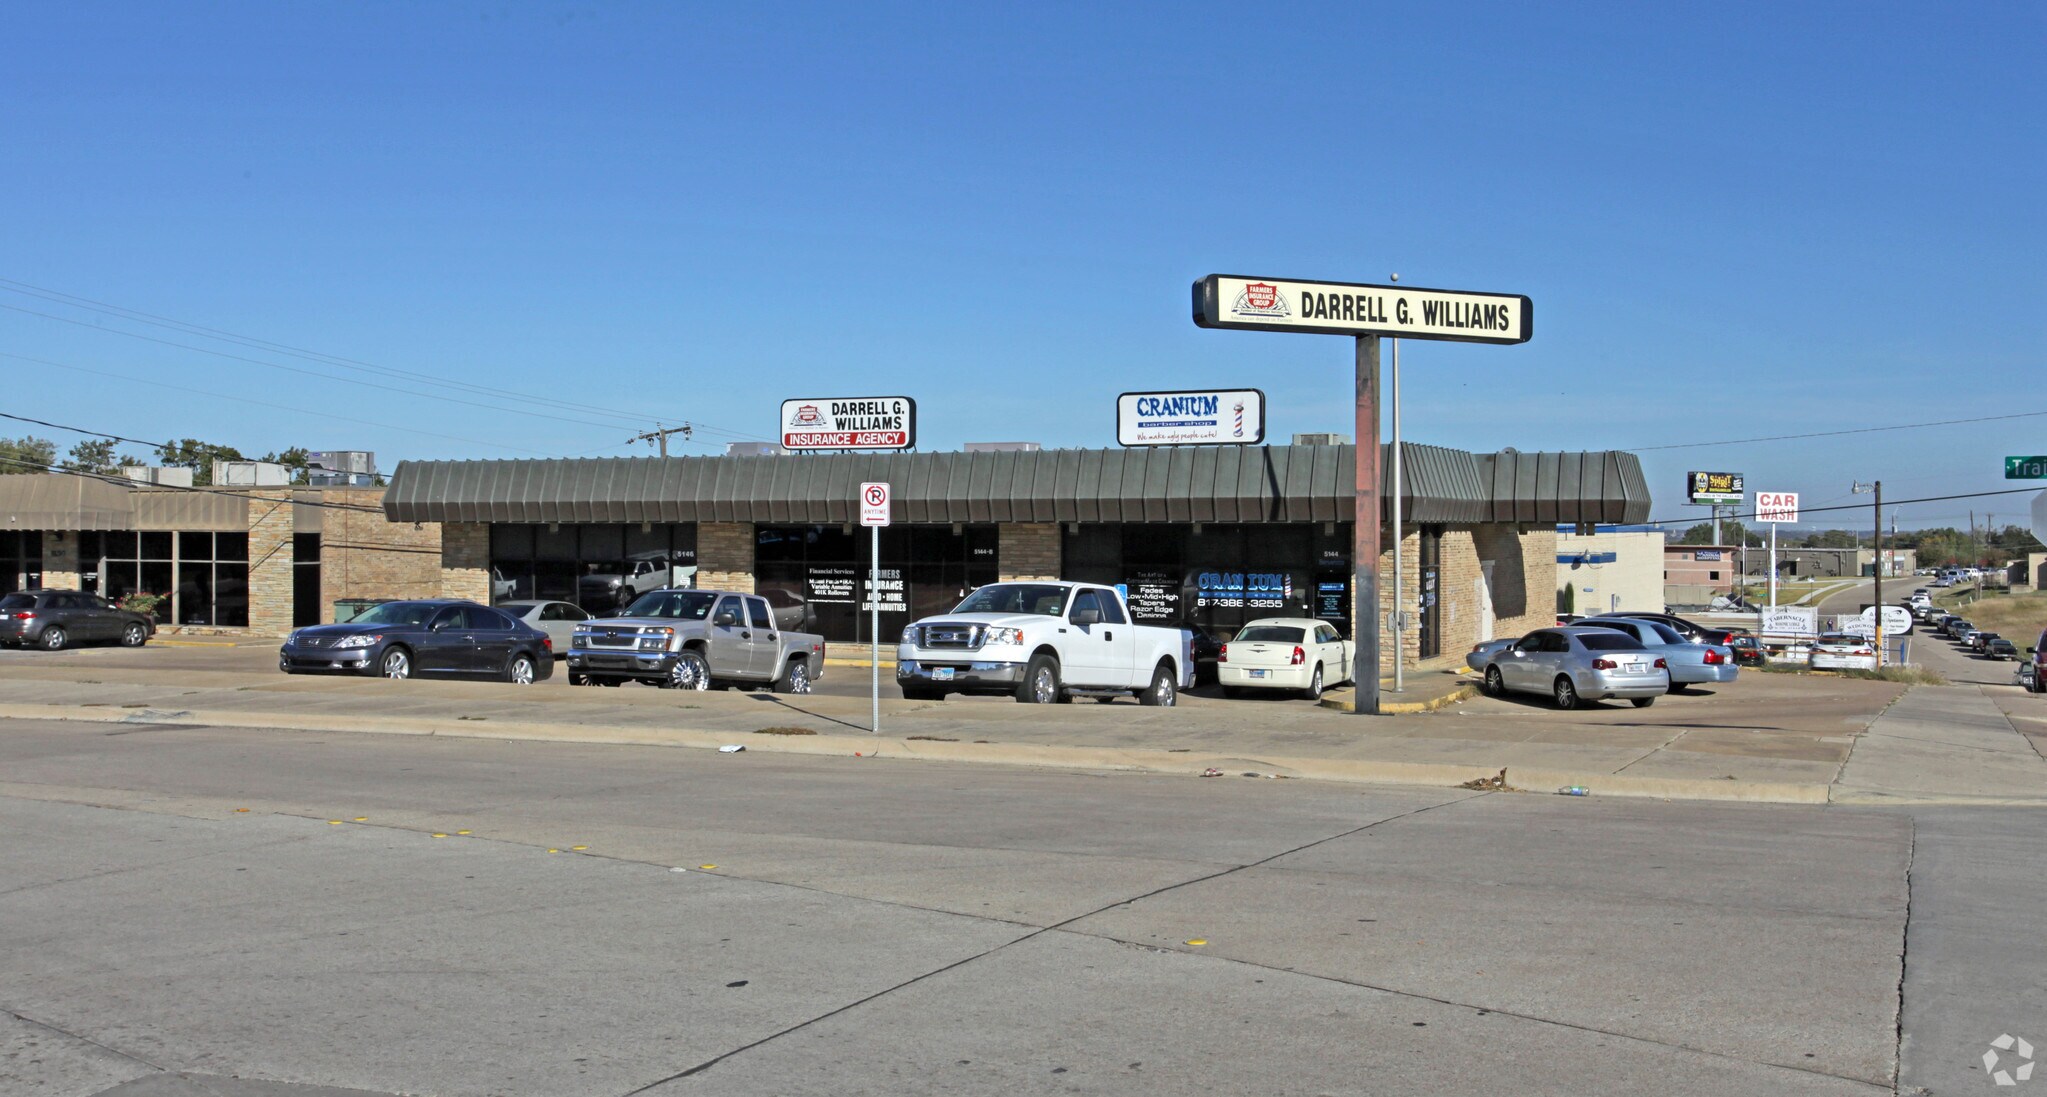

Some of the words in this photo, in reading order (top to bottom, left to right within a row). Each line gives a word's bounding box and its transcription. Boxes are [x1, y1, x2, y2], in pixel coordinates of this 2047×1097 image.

[1302, 292, 1388, 323] DARRELL
[1396, 298, 1413, 325] G.
[1423, 300, 1510, 331] WILLIAMS
[832, 402, 888, 416] DARRELL
[893, 401, 904, 414] G.
[1137, 395, 1218, 418] CRANIUM
[835, 416, 902, 430] WILLIAMS
[790, 433, 851, 445] INSURANCE
[855, 433, 900, 444] AGENCY
[1137, 432, 1147, 440] We
[1181, 430, 1199, 440] people
[1760, 494, 1794, 506] CAR
[1760, 508, 1794, 521] WASH
[869, 569, 900, 579] FRMERS
[865, 580, 903, 590] INURANCE
[867, 593, 882, 601] AUO
[886, 593, 902, 602] HOME
